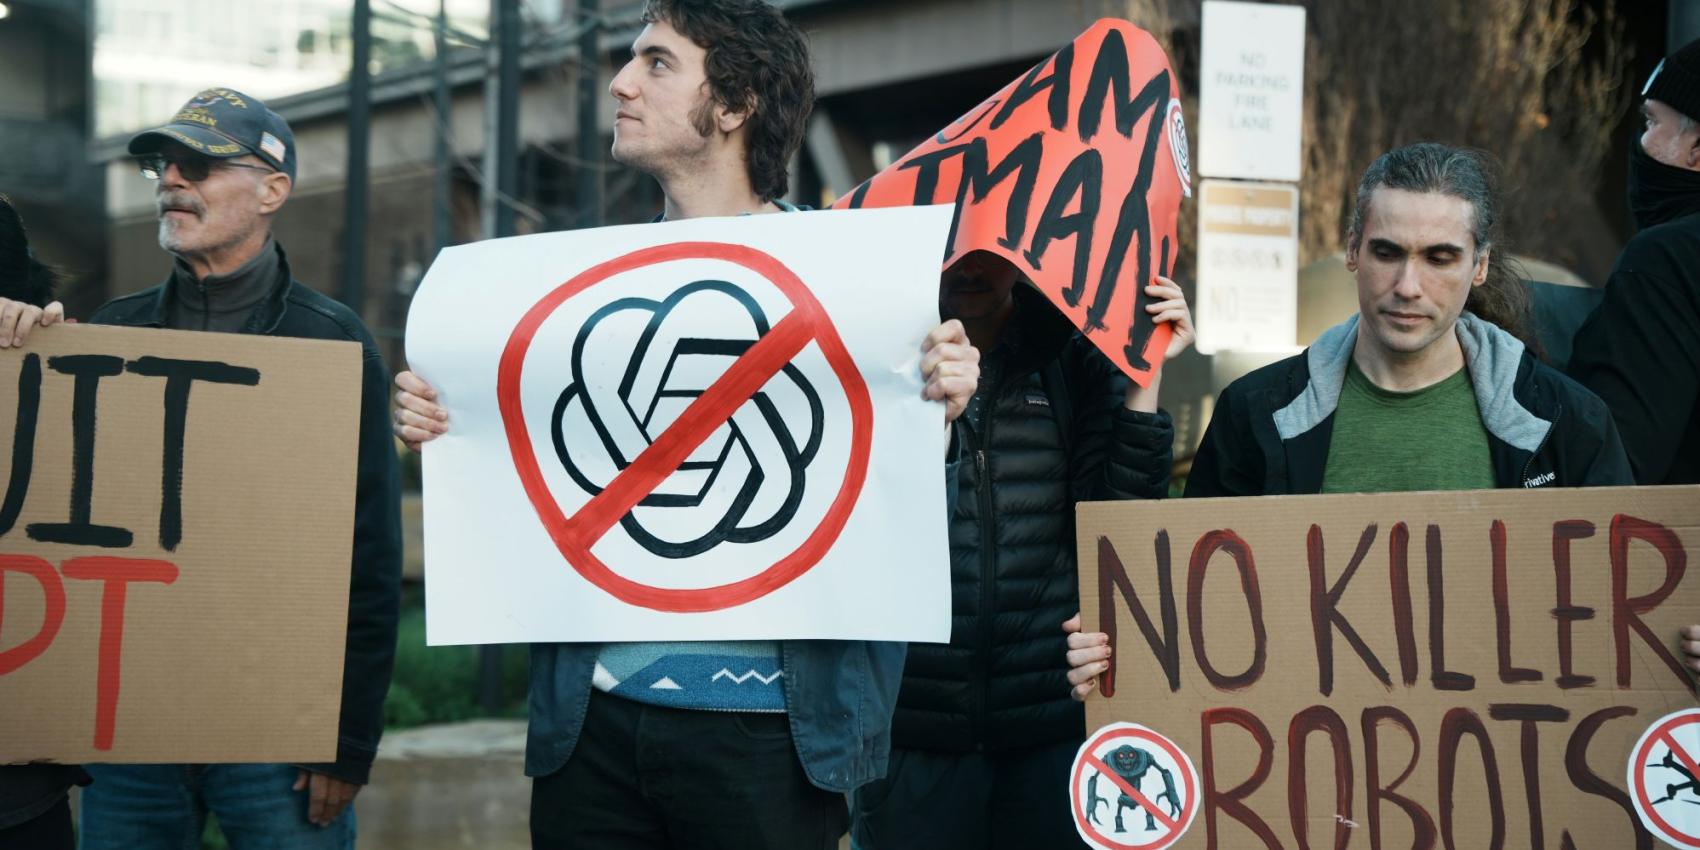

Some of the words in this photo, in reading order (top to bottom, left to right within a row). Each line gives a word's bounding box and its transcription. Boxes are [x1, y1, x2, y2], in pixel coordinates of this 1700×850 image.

[1240, 52, 1266, 69] NO
[1216, 71, 1290, 92] PARKING
[1233, 92, 1271, 111] FIRE
[1228, 112, 1273, 133] LANE
[822, 132, 1169, 371] TMAN
[1097, 528, 1267, 698] NO
[1306, 513, 1700, 698] KILLER
[1201, 704, 1655, 850] ROBOTS
